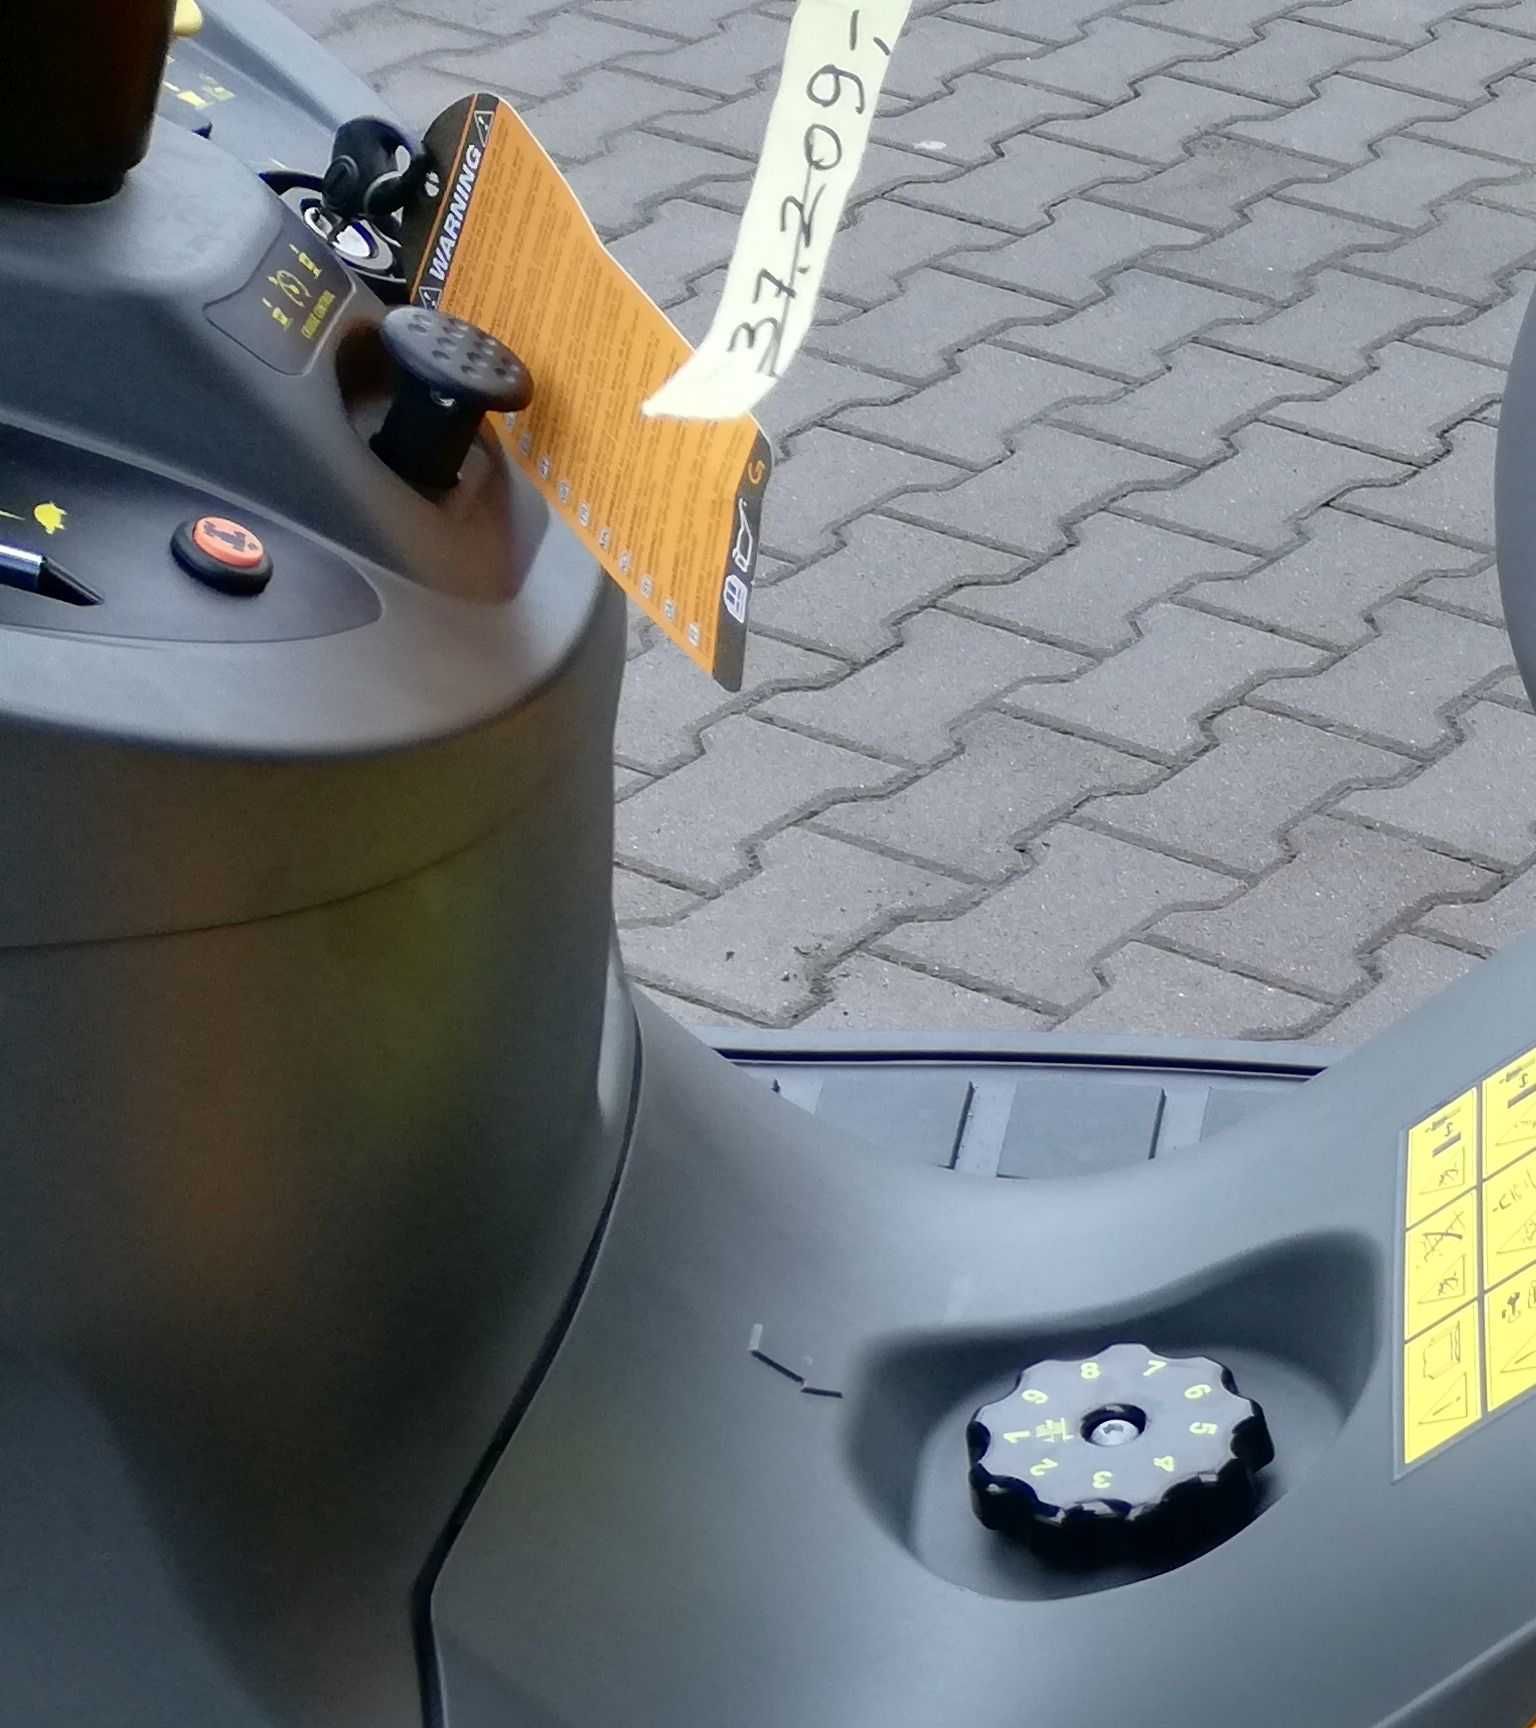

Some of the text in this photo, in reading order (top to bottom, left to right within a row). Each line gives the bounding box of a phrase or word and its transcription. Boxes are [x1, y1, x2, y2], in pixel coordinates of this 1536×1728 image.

[429, 144, 483, 281] WARNING
[1080, 1362, 1101, 1380] 8
[1143, 1359, 1168, 1377] 7
[1021, 1388, 1048, 1405] 9
[1184, 1383, 1212, 1400] 6
[1003, 1429, 1032, 1444] 1
[1189, 1421, 1218, 1436] 5
[1029, 1457, 1059, 1477] 2
[1153, 1455, 1176, 1472] 4
[1092, 1470, 1113, 1489] 3
